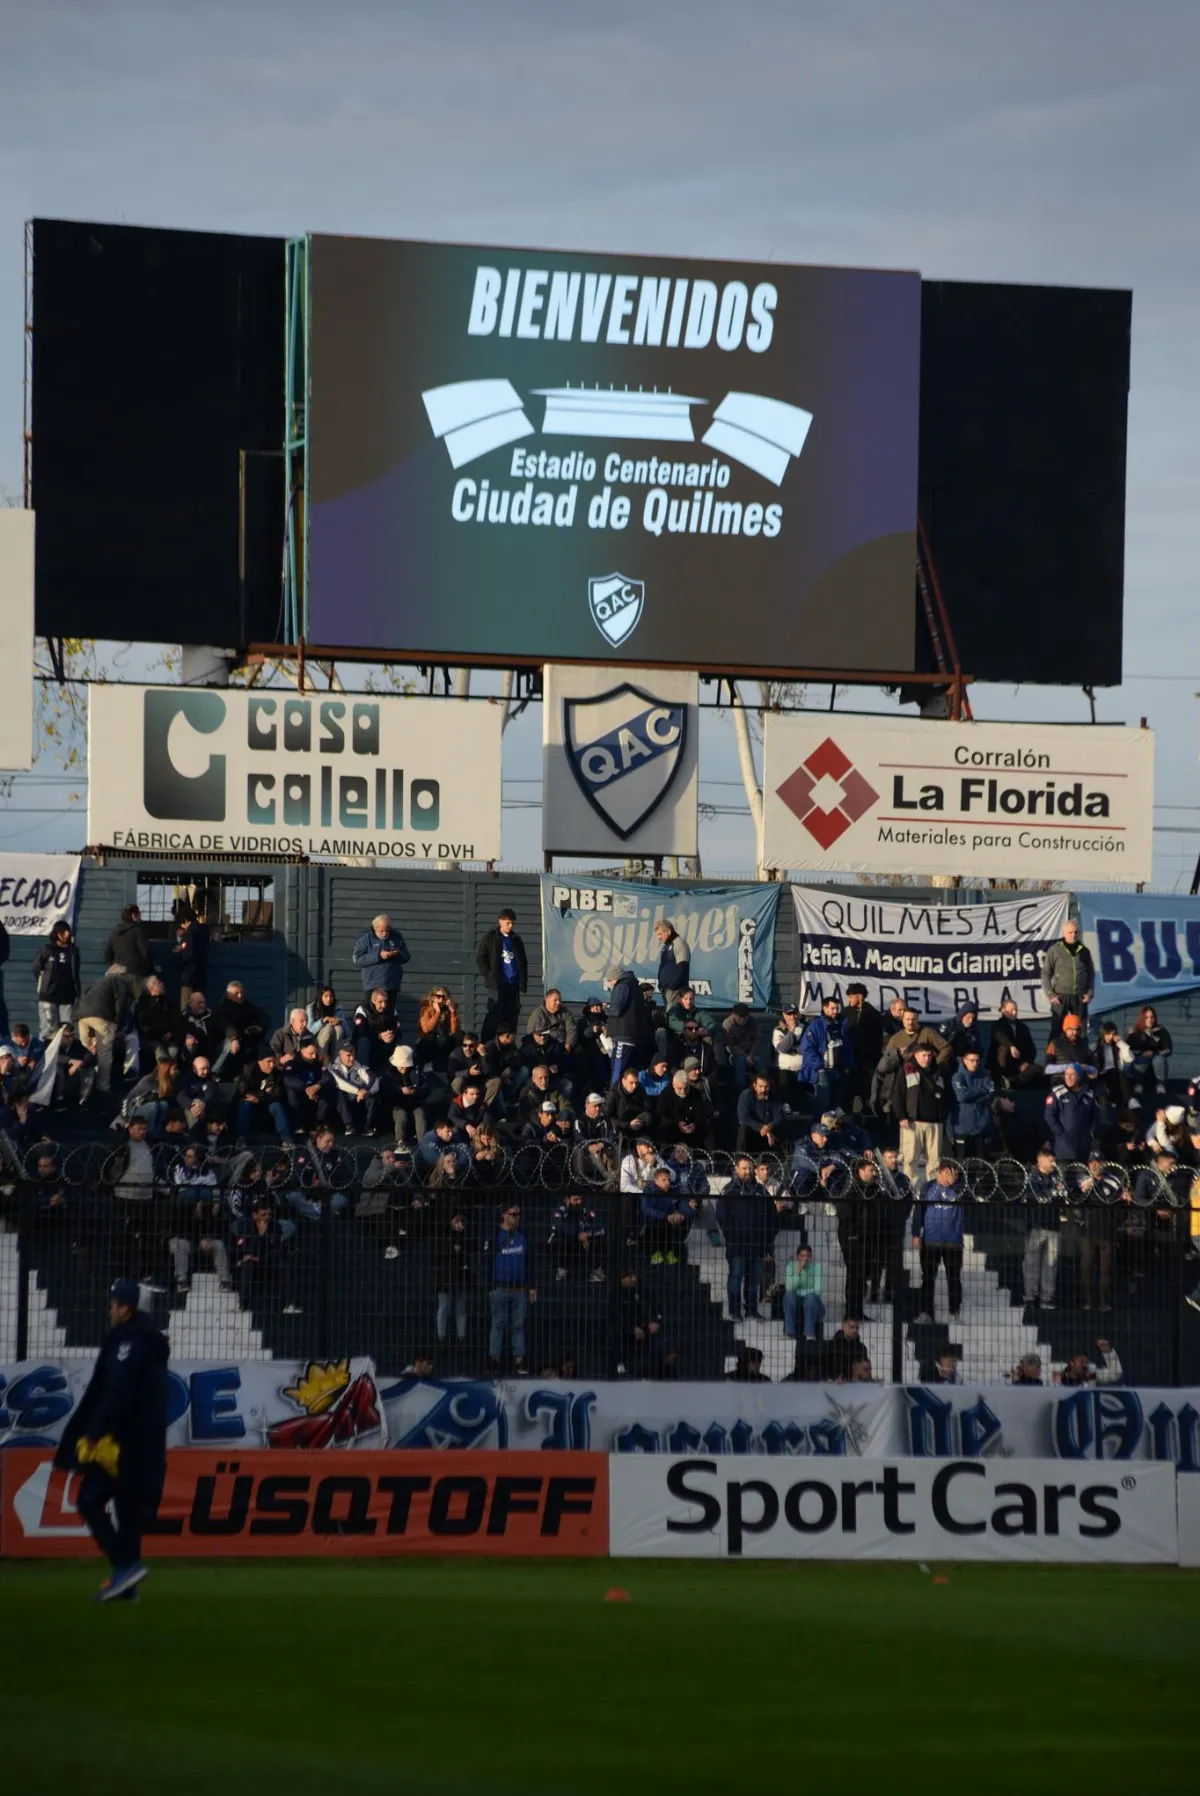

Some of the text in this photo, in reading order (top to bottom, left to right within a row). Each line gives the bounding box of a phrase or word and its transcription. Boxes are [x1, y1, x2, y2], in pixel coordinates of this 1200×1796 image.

[467, 266, 779, 353] BIENVENIDOS
[510, 447, 731, 488] Estadio Centenario
[451, 478, 783, 538] Ciudad de Quilmes
[596, 583, 636, 620] QAC
[580, 709, 680, 783] QAC
[954, 745, 1051, 769] Corralón
[892, 775, 1110, 818] La Florida
[113, 829, 475, 860] FÁBRICA DE VIDRIOS LAMINADOS Y DVH
[877, 826, 1126, 853] Materiales para Construcción
[553, 886, 613, 912] PIBE
[822, 900, 973, 936] QUILMES
[803, 943, 842, 967] Peña
[879, 985, 943, 1014] DEL
[954, 984, 1043, 1014] PLAT
